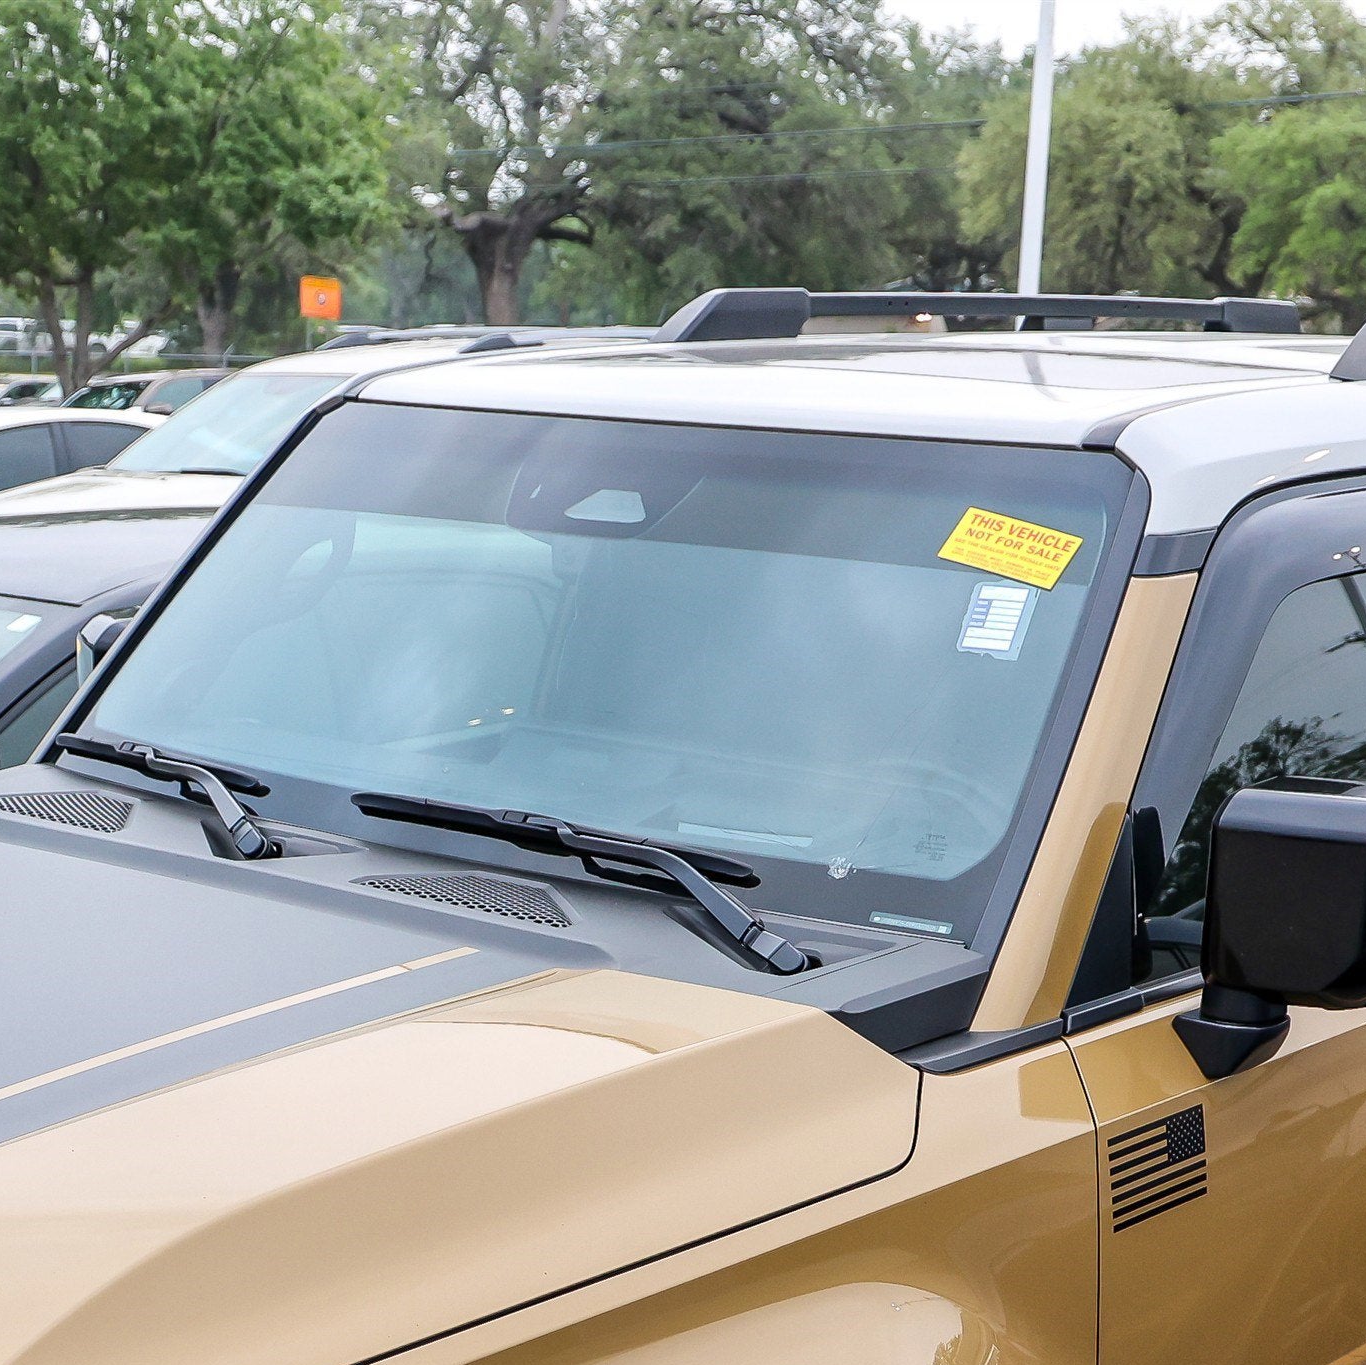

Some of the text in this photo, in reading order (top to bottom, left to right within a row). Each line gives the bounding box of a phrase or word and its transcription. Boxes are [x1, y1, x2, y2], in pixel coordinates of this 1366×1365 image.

[965, 527, 1063, 562] NOT FOR SALE
[970, 513, 1076, 552] THIS VEHICLE
